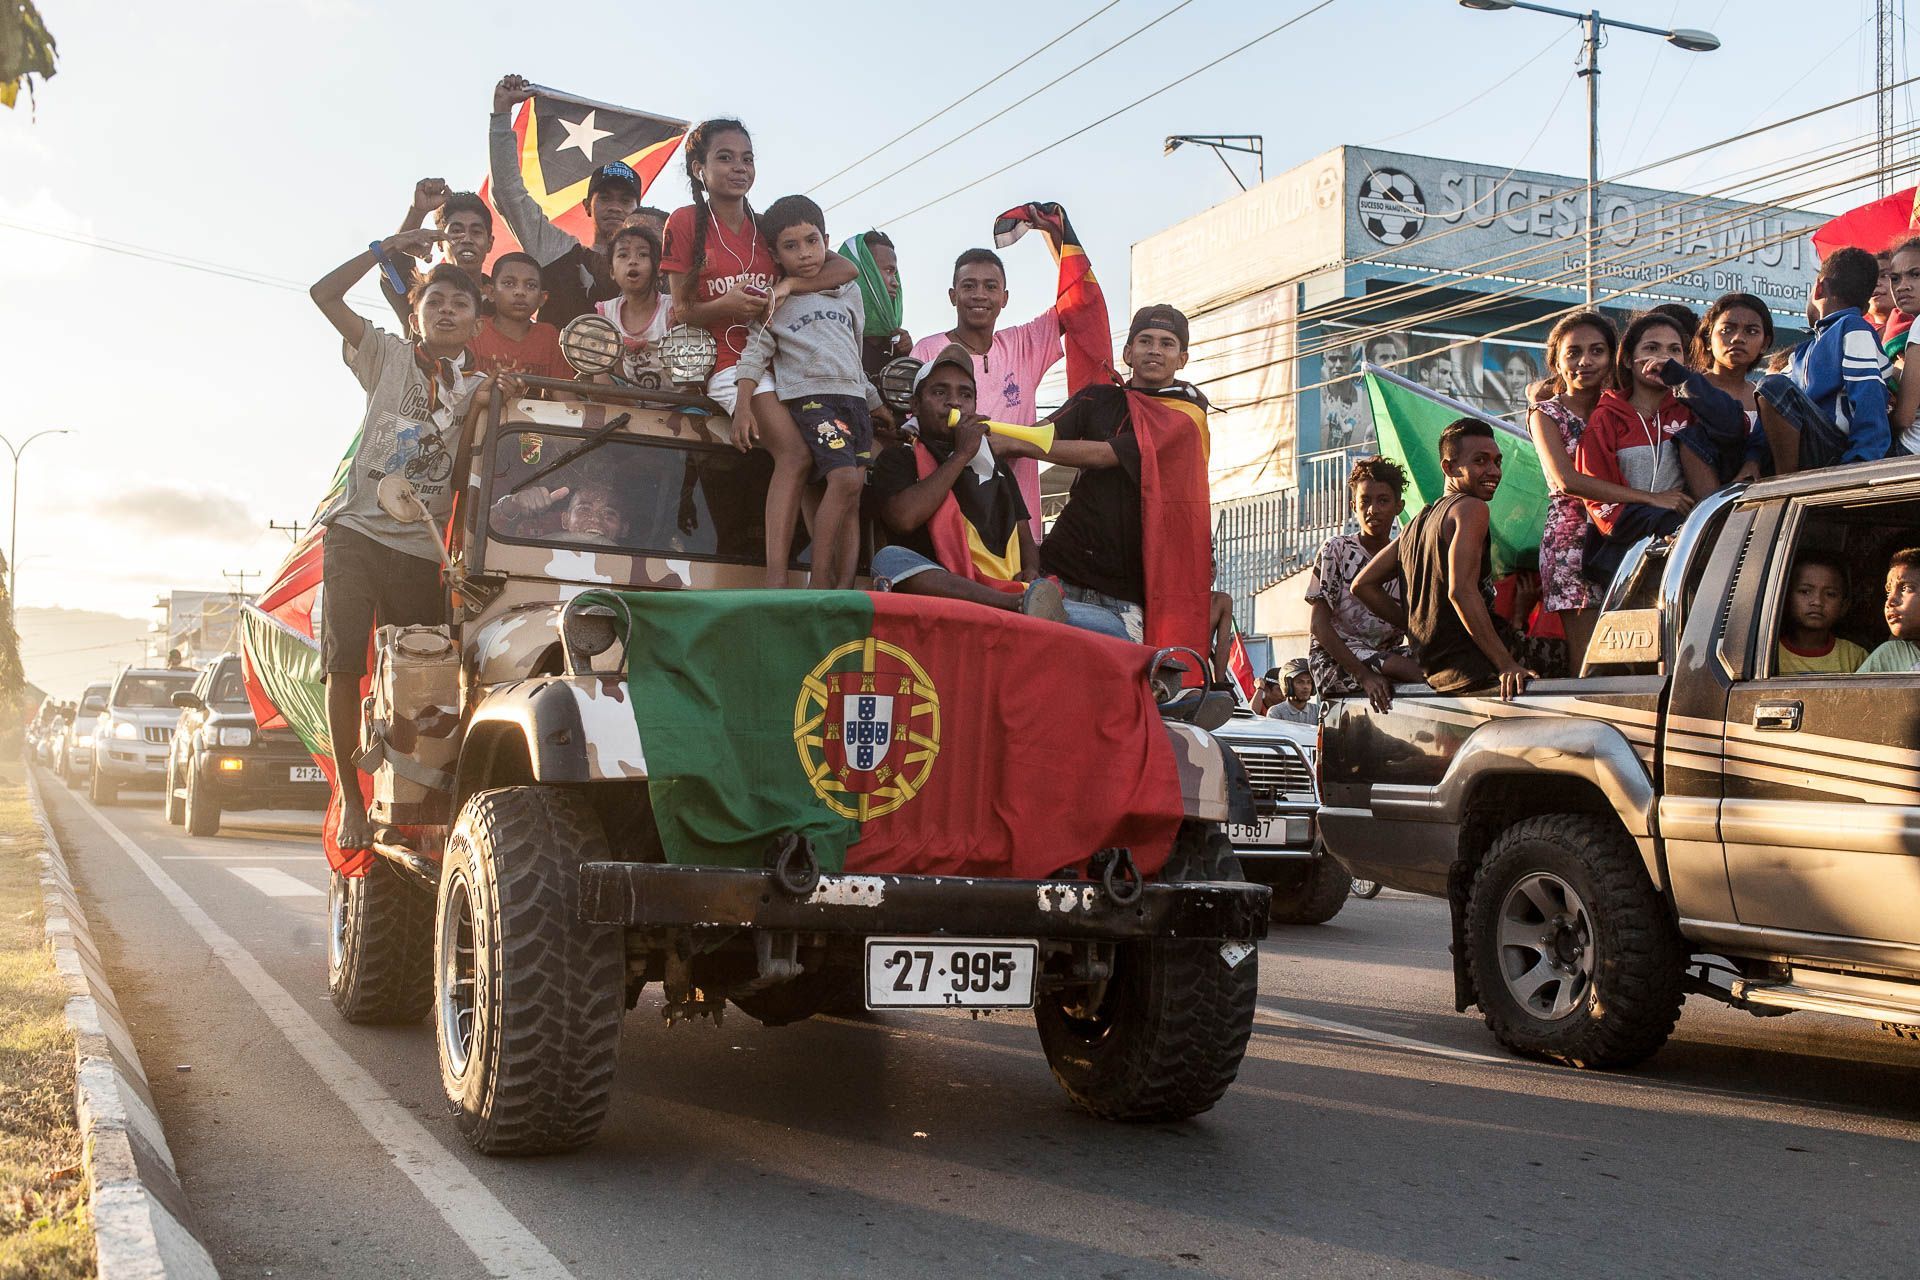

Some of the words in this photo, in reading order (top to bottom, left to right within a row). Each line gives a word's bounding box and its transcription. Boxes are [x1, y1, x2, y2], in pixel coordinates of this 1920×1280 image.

[1360, 200, 1384, 210] SUCESSO
[706, 272, 779, 296] PORTUGA
[1563, 252, 1650, 282] Ladmark
[1656, 264, 1709, 290] Plaza,
[1714, 271, 1748, 294] Dili,
[1598, 624, 1654, 649] 4WD
[942, 993, 963, 1004] TL
